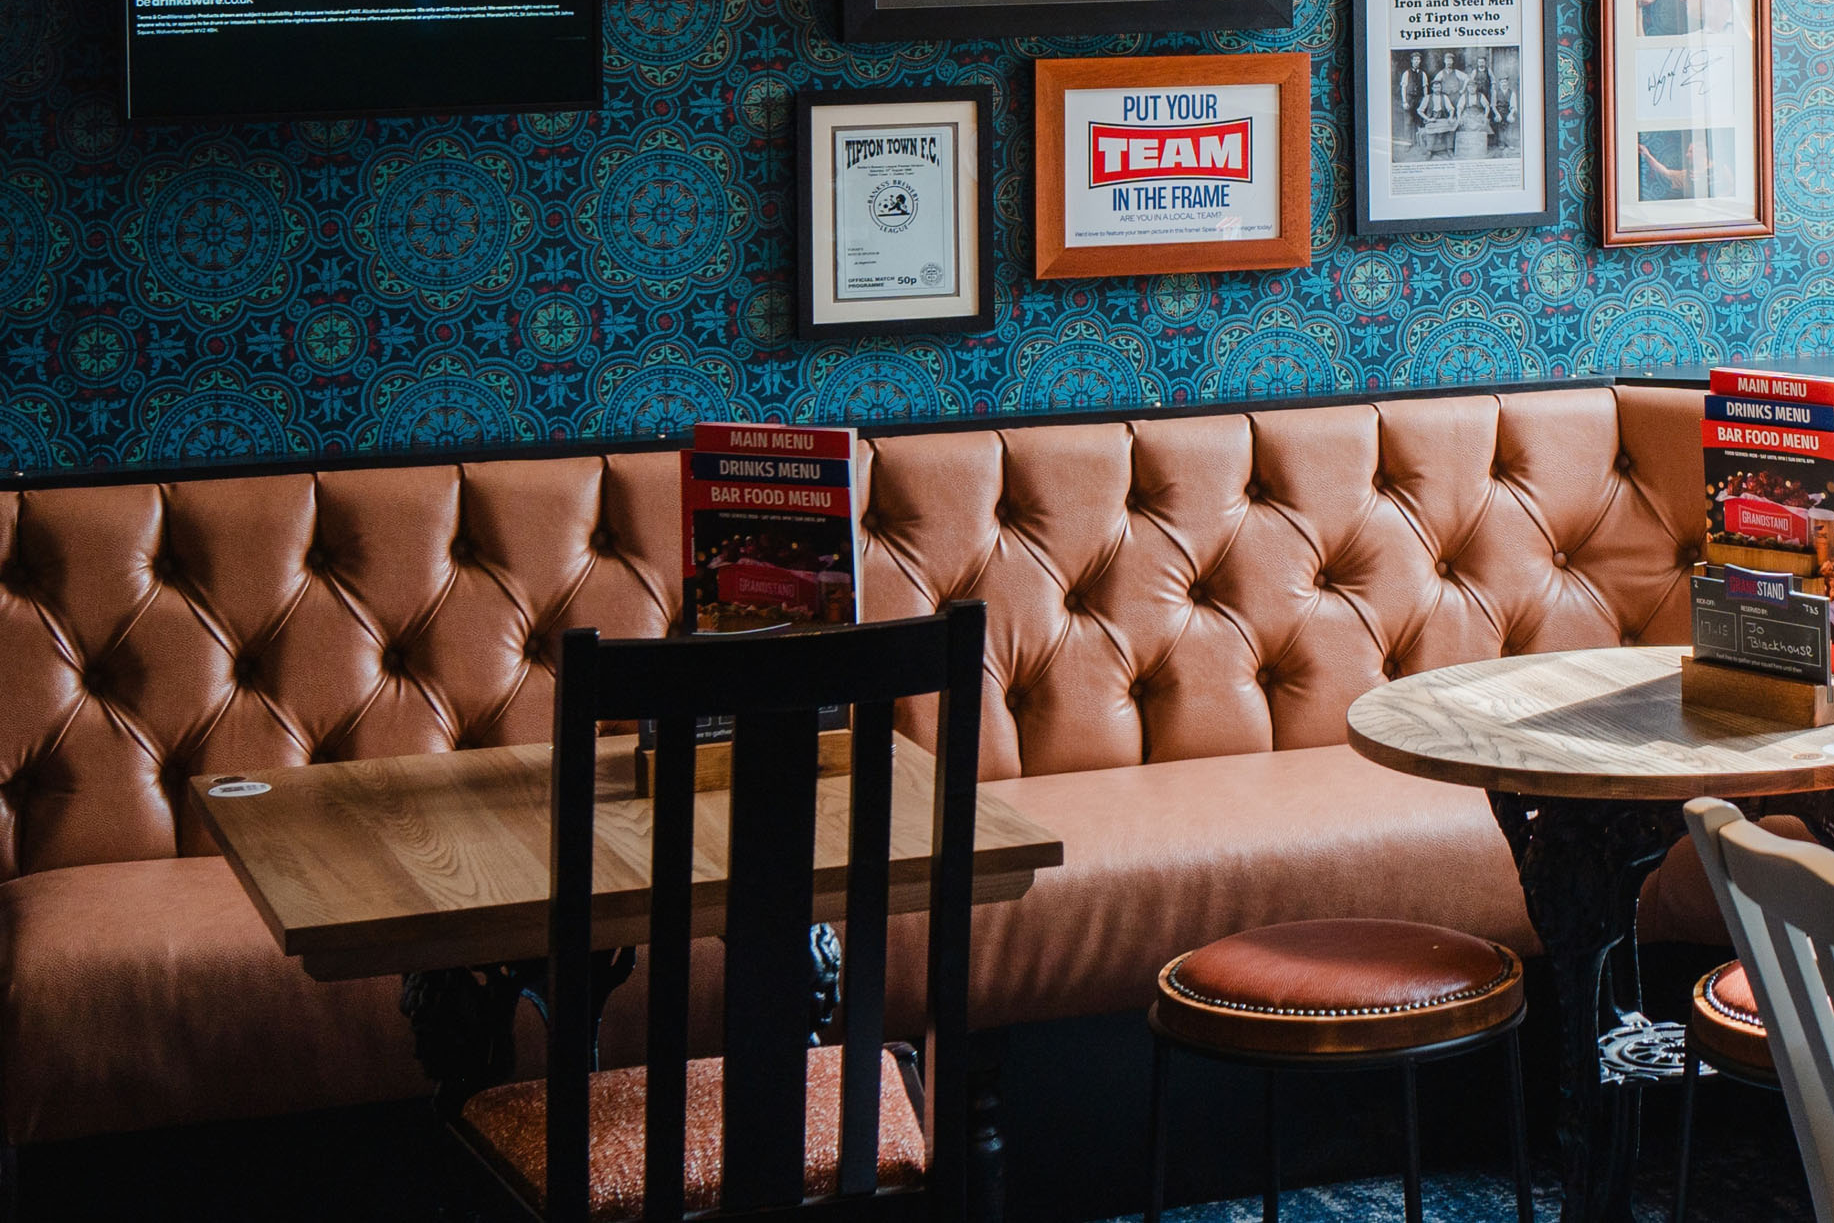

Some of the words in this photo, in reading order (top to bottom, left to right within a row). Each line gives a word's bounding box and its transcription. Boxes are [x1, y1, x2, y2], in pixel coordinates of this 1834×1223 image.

[1408, 12, 1422, 23] of
[1424, 11, 1469, 25] Tipton
[1474, 10, 1501, 22] who
[1400, 28, 1451, 40] typified
[1122, 94, 1161, 121] PUT
[1165, 93, 1218, 120] YOUR
[845, 139, 884, 170] TIPTON
[886, 137, 918, 157] TOWN
[920, 136, 940, 167] F.C.
[1098, 131, 1243, 174] TEAM
[1112, 186, 1130, 212] IN
[1133, 185, 1167, 211] THE
[1171, 183, 1231, 210] FRAME
[1119, 214, 1136, 222] ARE
[1136, 214, 1153, 222] YOU
[1153, 213, 1162, 221] IN
[1161, 213, 1169, 221] A
[1169, 212, 1194, 221] LOCAL
[1196, 211, 1223, 220] TEAM?
[879, 224, 908, 234] LEAGUE
[897, 276, 918, 286] 50p
[1737, 377, 1769, 395] MAIN
[1772, 380, 1807, 398] MENU
[1726, 401, 1773, 418] DRINKS
[1775, 405, 1811, 424] MENU
[730, 431, 768, 448] MAIN
[772, 433, 815, 450] MENU
[1717, 426, 1743, 443] BAR
[1745, 429, 1780, 447] FOOD
[1782, 433, 1820, 451] MENU
[719, 459, 775, 478] DRINKS
[778, 461, 821, 480] MENU
[711, 486, 741, 504] BAR
[744, 487, 785, 505] FOOD
[788, 490, 832, 508] MENU
[1741, 510, 1789, 531] GRANDSTAND
[739, 578, 796, 598] GRANDSTAND
[1745, 622, 1765, 635] Jo
